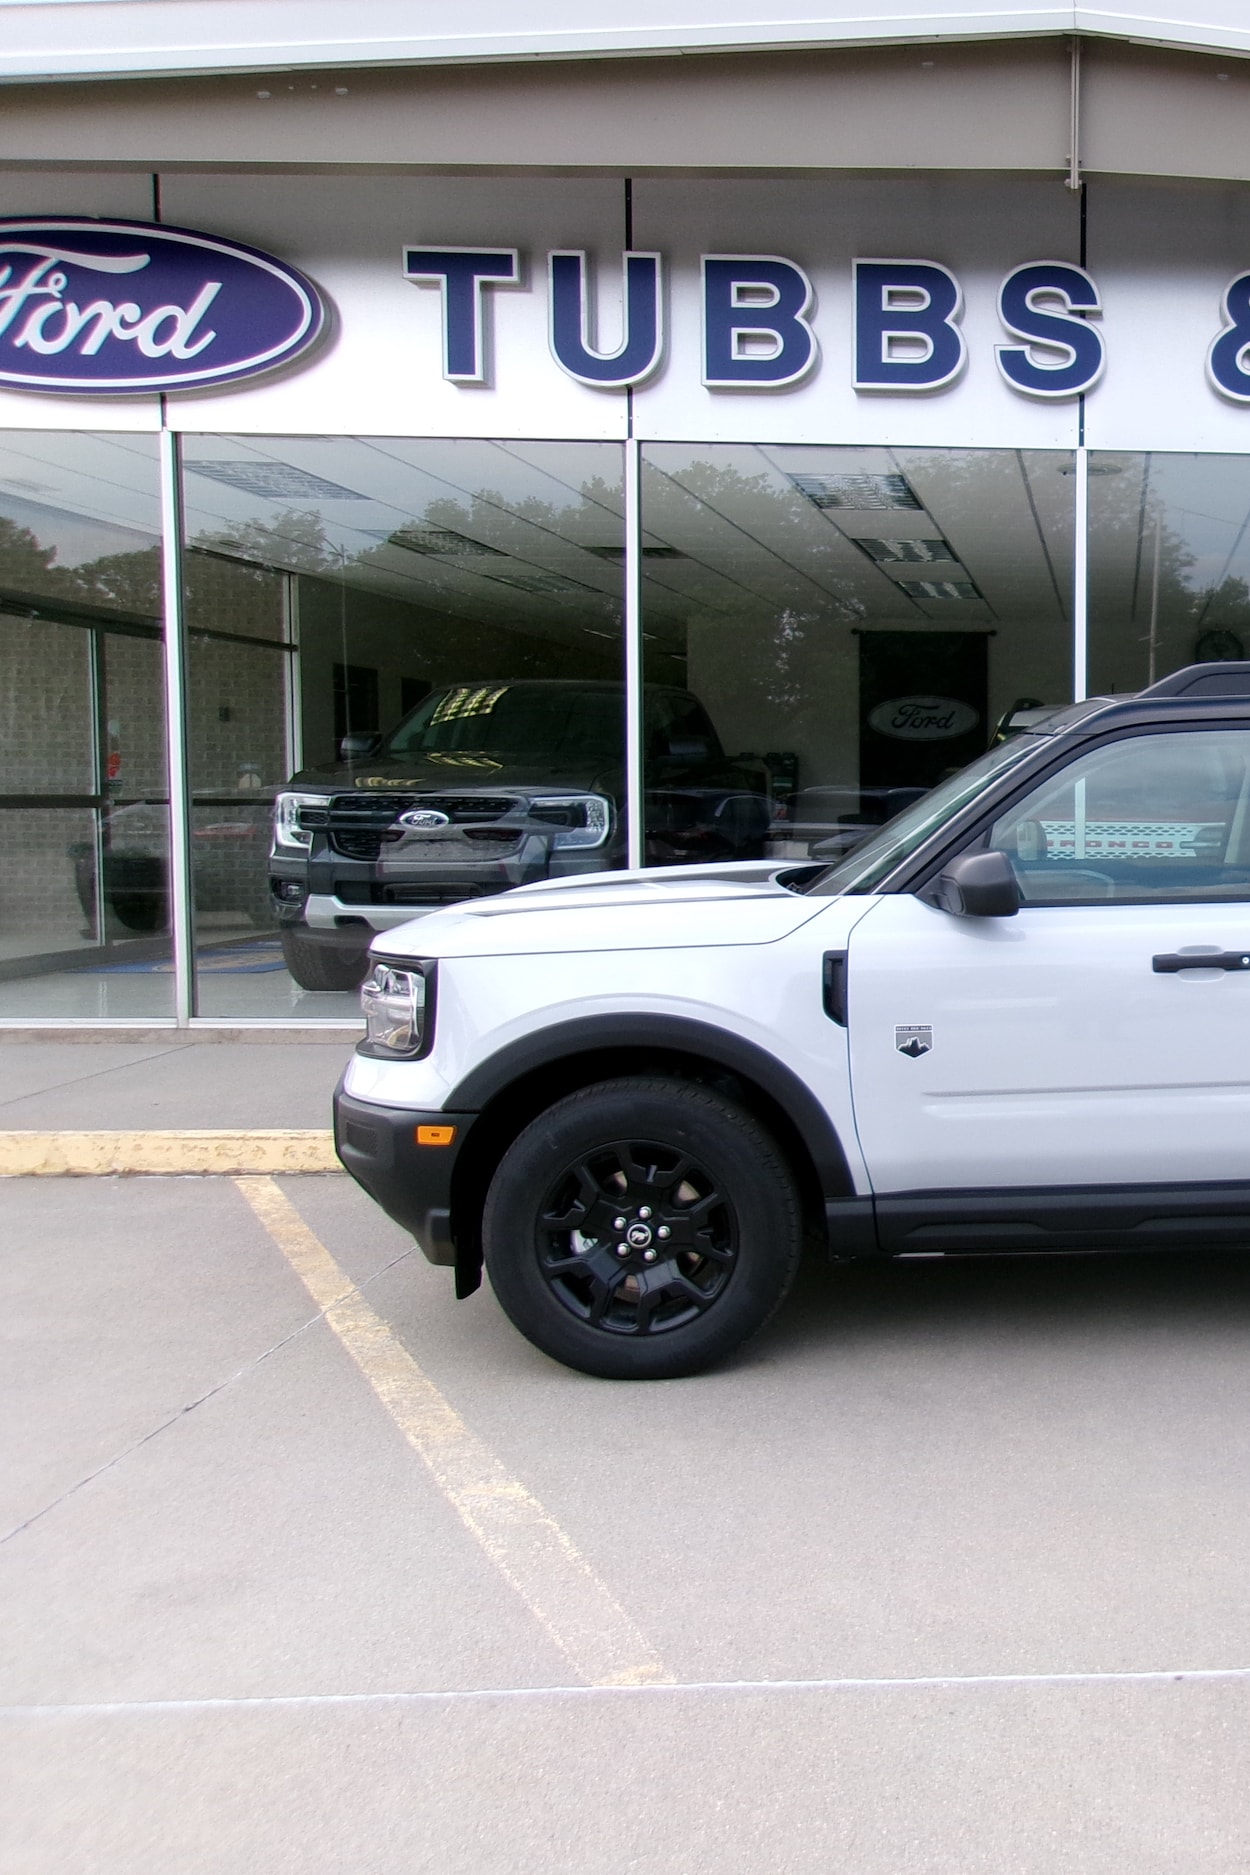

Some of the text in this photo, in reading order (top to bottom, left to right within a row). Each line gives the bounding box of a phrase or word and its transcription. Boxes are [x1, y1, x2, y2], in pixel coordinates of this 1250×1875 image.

[402, 245, 1107, 398] TUBBS
[892, 704, 956, 729] Ford
[411, 814, 438, 826] Ford
